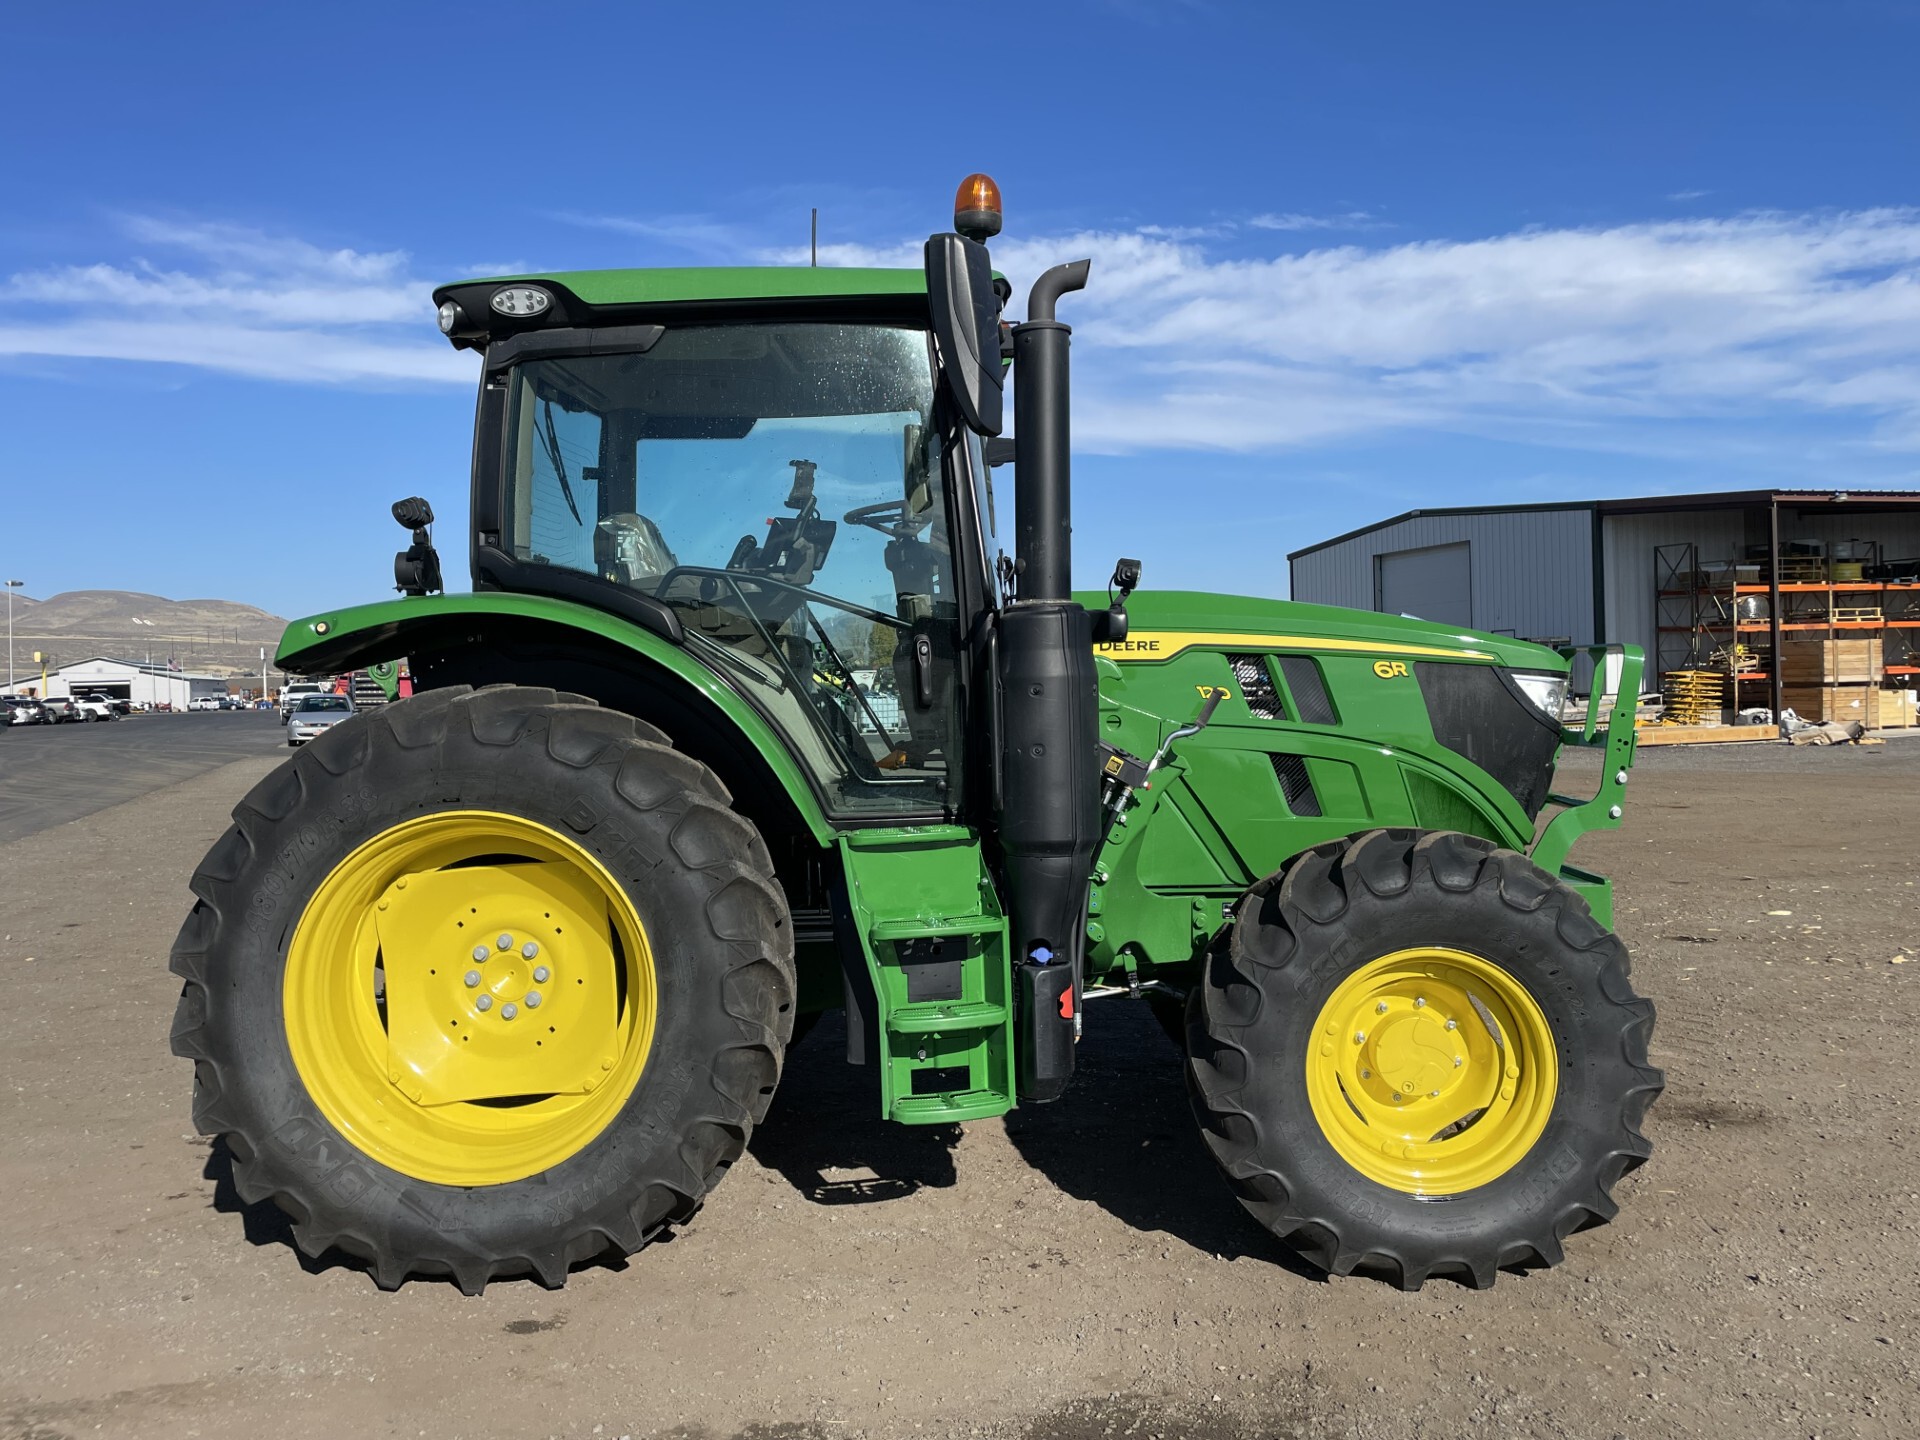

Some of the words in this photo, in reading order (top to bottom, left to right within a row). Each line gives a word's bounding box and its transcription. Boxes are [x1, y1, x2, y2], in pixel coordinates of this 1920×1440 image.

[1099, 640, 1160, 651] DEERE
[1373, 660, 1410, 679] 6R
[560, 794, 663, 883] BKT
[266, 1116, 378, 1210] BKT
